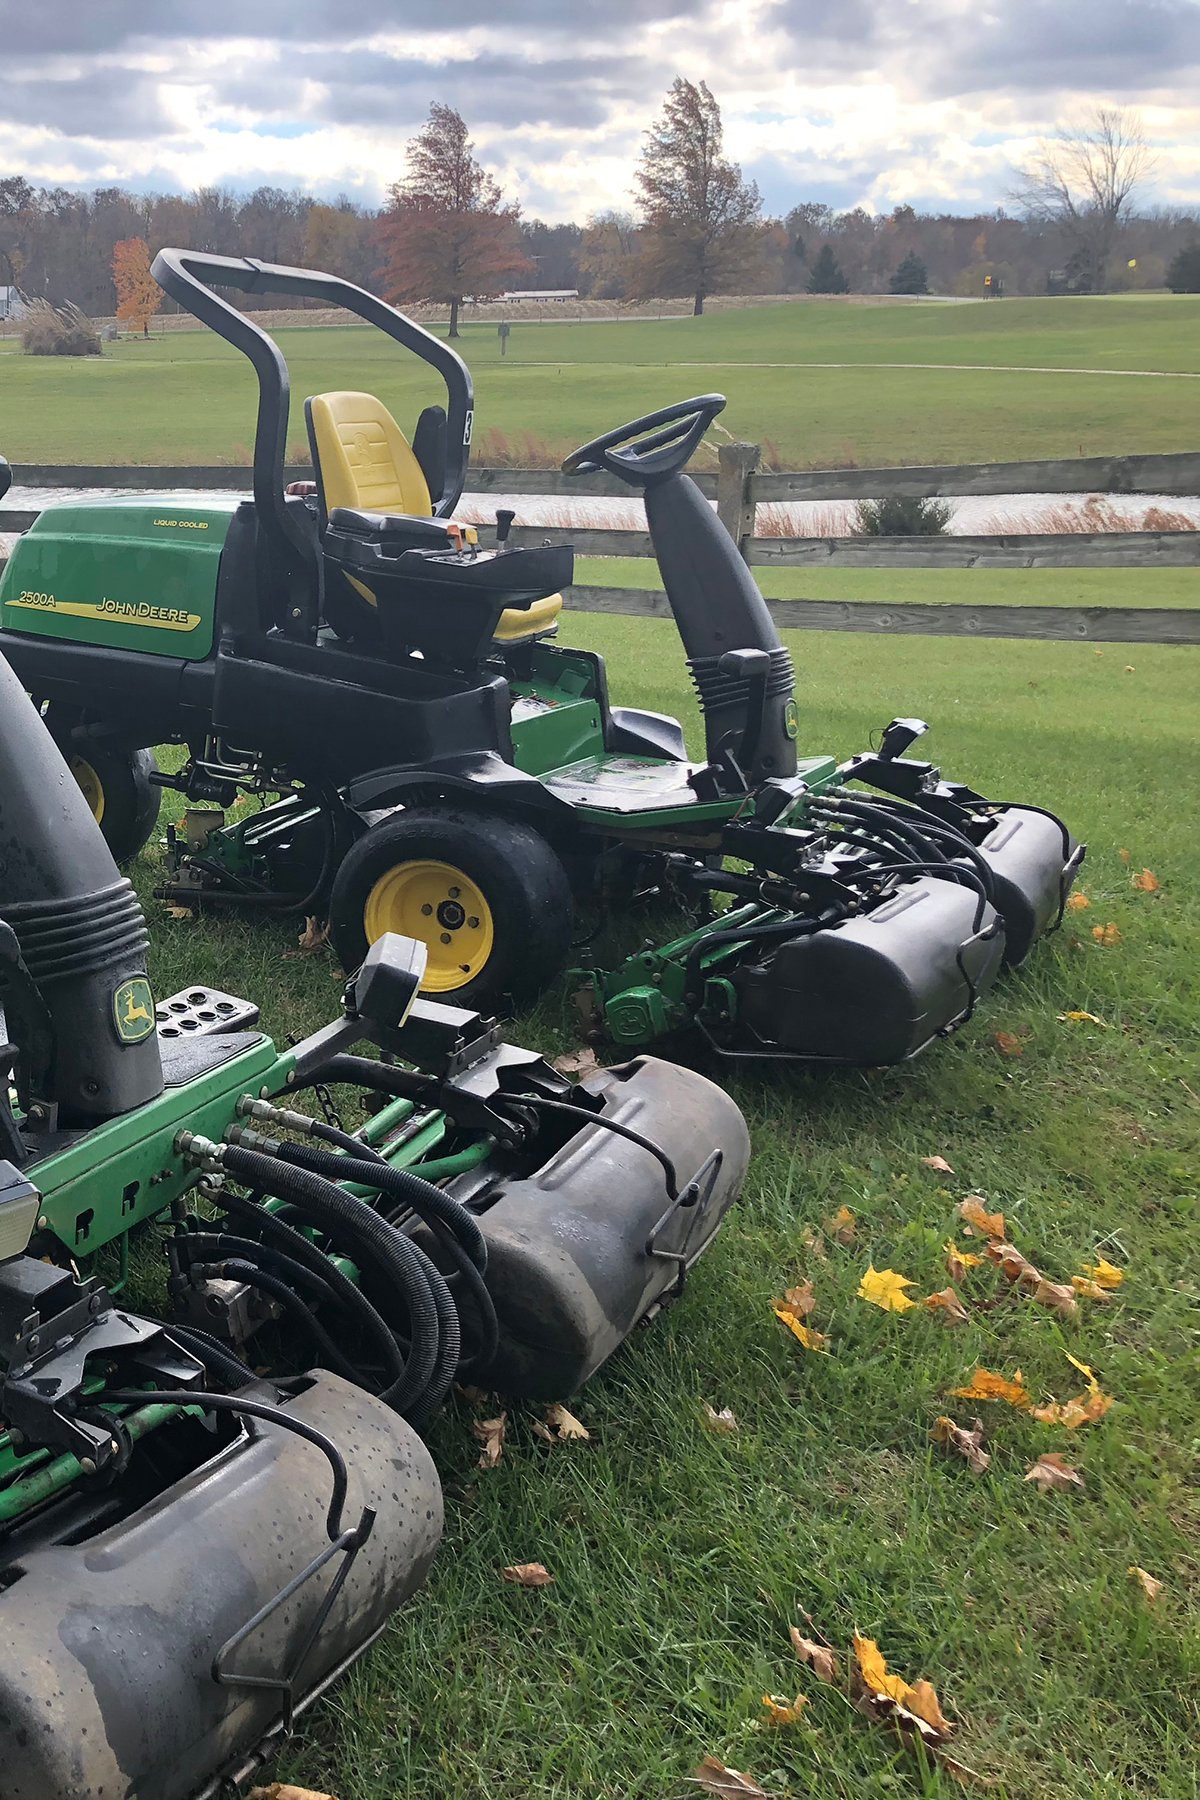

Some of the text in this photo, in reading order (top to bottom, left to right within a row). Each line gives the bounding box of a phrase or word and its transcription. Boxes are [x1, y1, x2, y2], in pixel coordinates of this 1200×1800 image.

[464, 412, 473, 444] 3
[153, 519, 209, 529] LIQUID COOLED
[19, 590, 56, 607] 2500A
[96, 597, 188, 624] JOHN DEERE
